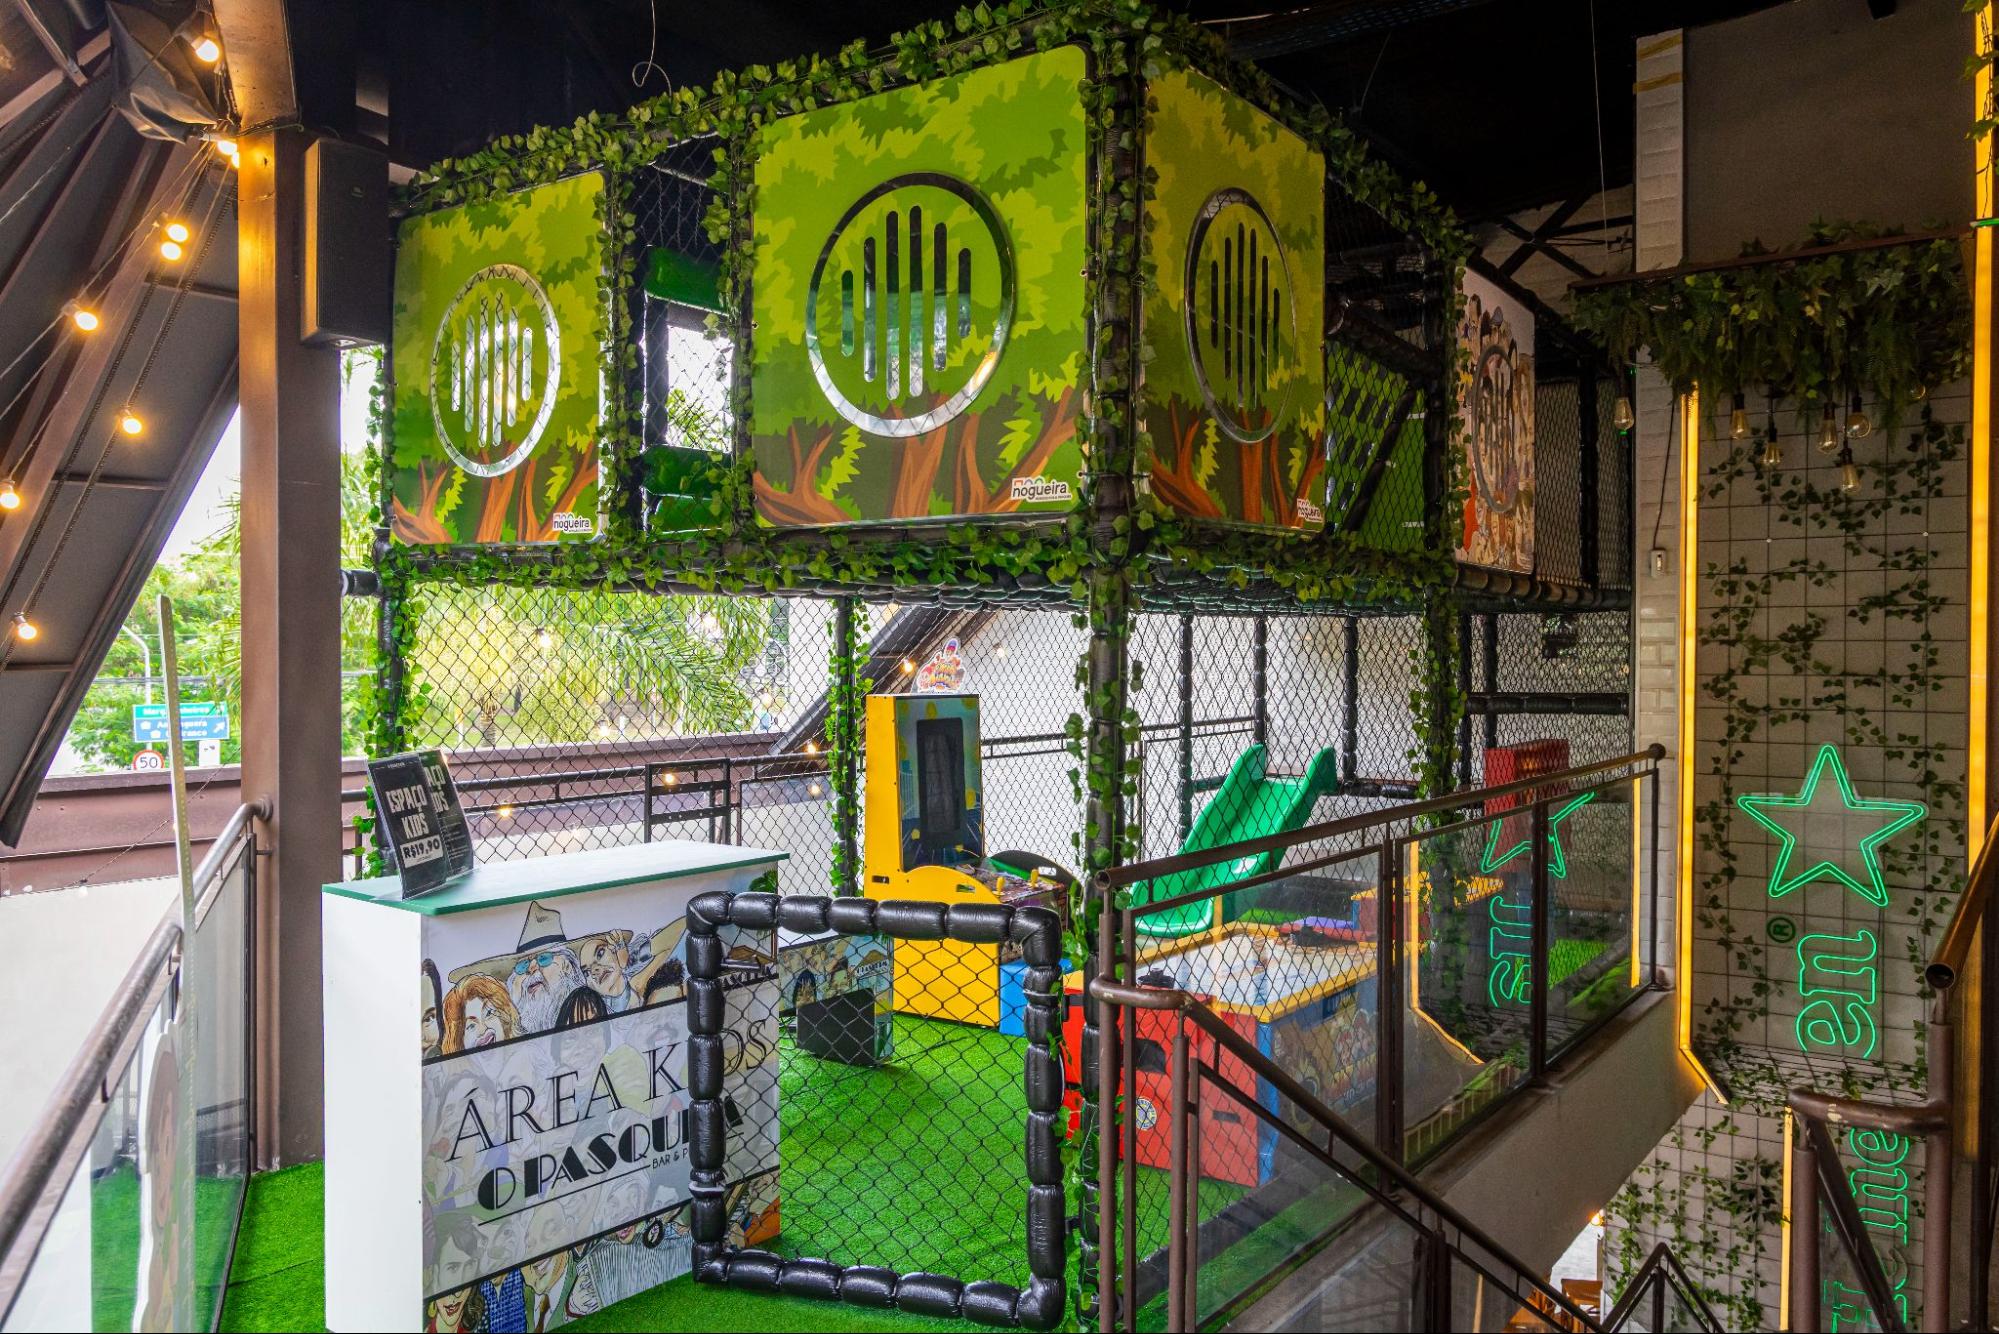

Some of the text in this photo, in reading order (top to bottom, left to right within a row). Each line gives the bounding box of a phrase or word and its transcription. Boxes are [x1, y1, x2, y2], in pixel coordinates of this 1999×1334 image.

[1013, 482, 1067, 499] nogueira
[553, 517, 590, 531] nogueira
[139, 756, 159, 769] 50
[385, 784, 428, 814] ESPAÇO
[430, 791, 450, 813] IDS
[401, 812, 430, 840] KIDS
[402, 837, 441, 859] R$19,90
[444, 1018, 769, 1163] ÁREA KDS
[652, 1154, 671, 1170] BAR
[477, 1166, 516, 1211] O
